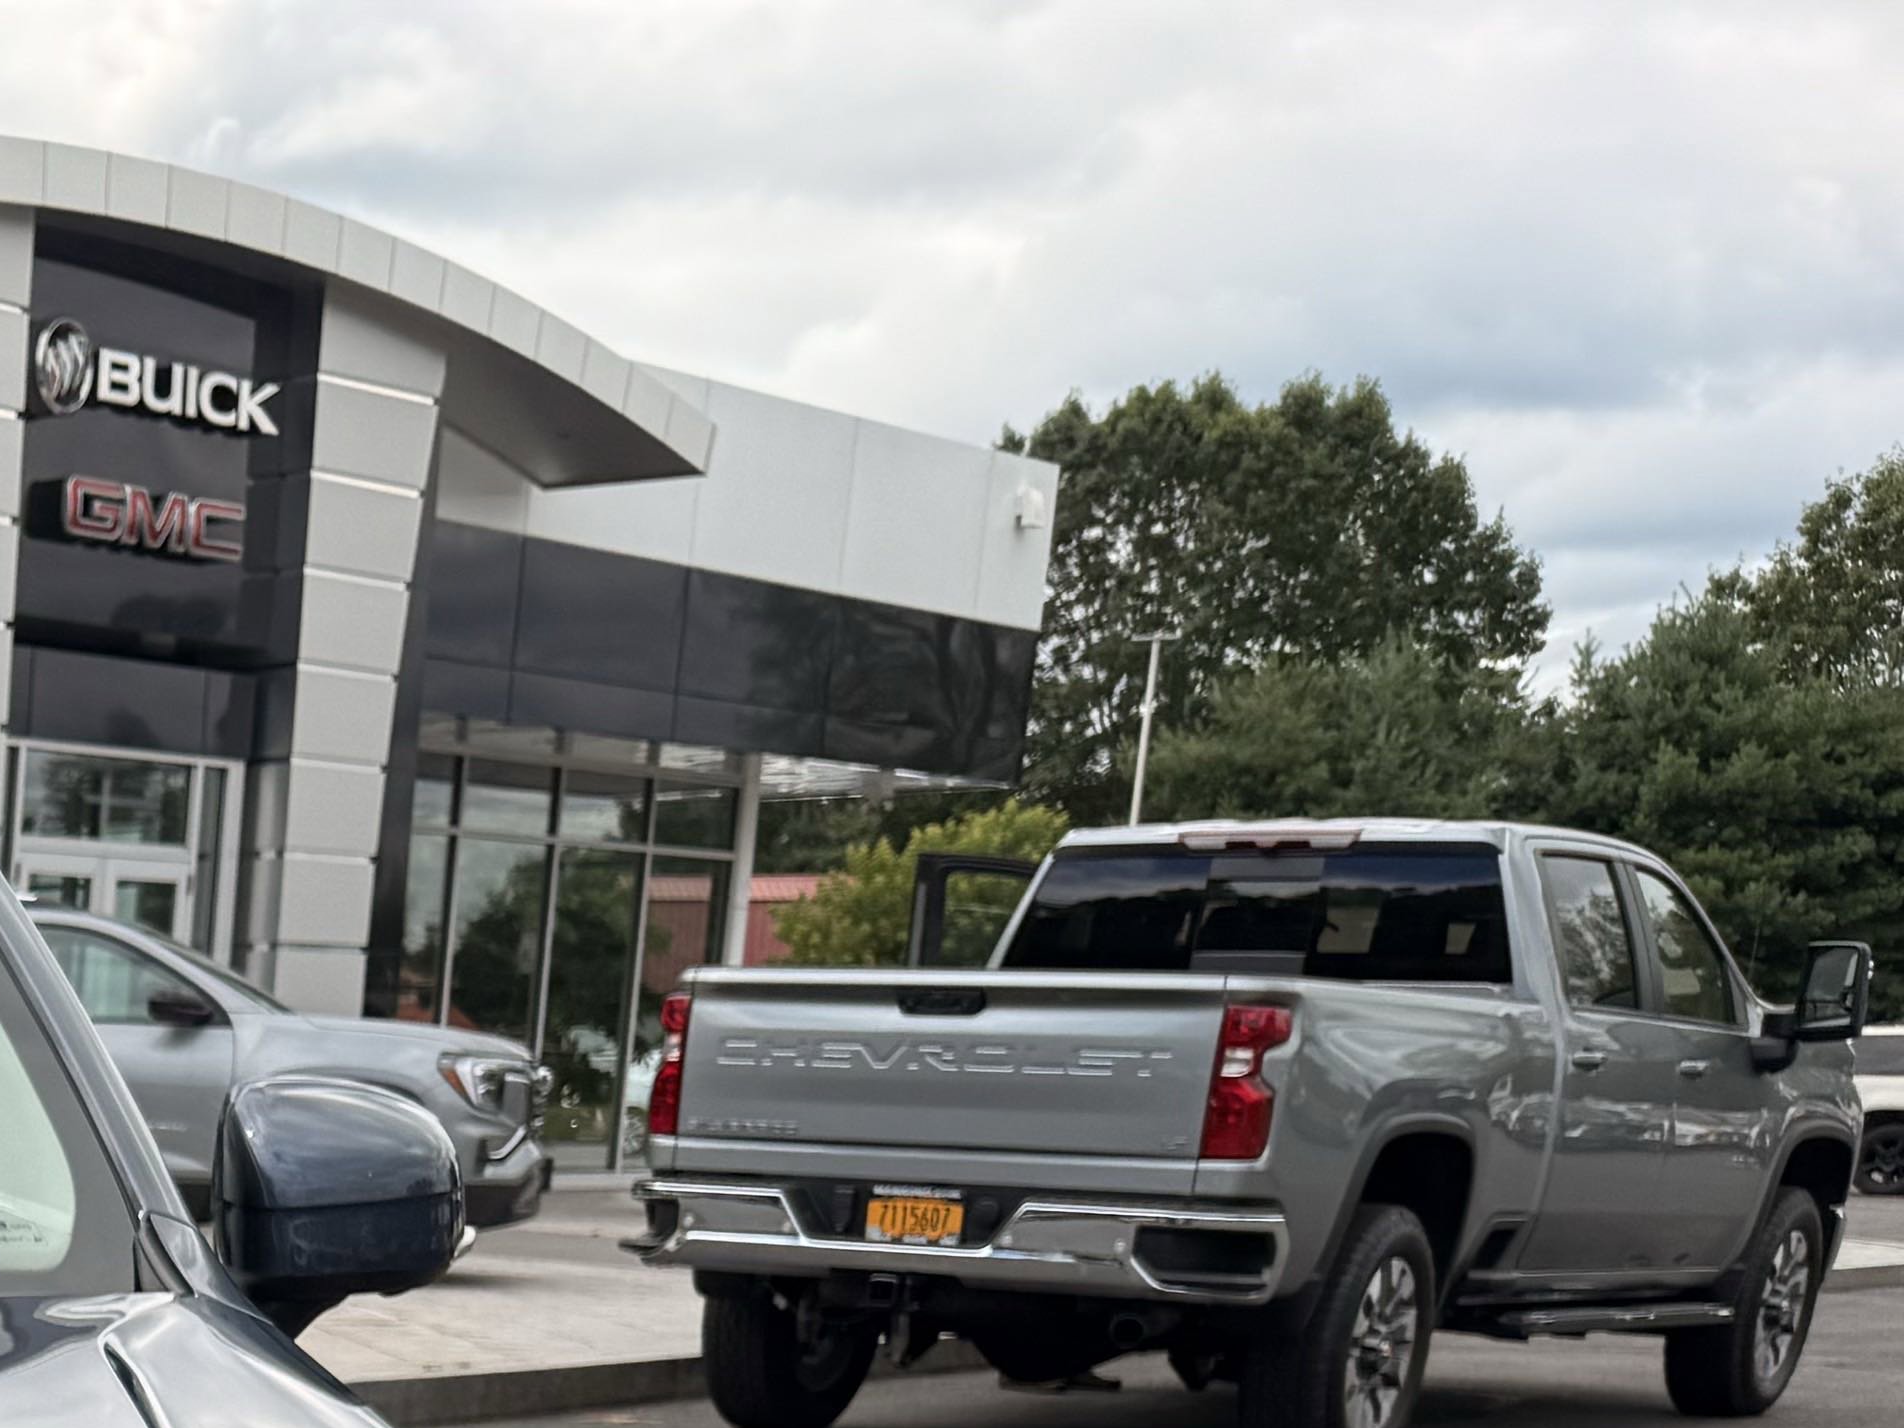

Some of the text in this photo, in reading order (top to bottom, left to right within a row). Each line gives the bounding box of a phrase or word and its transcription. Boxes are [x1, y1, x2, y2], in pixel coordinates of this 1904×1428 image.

[96, 347, 280, 436] BUICK
[64, 474, 246, 562] GMC
[716, 1039, 1173, 1077] CHEVROLET
